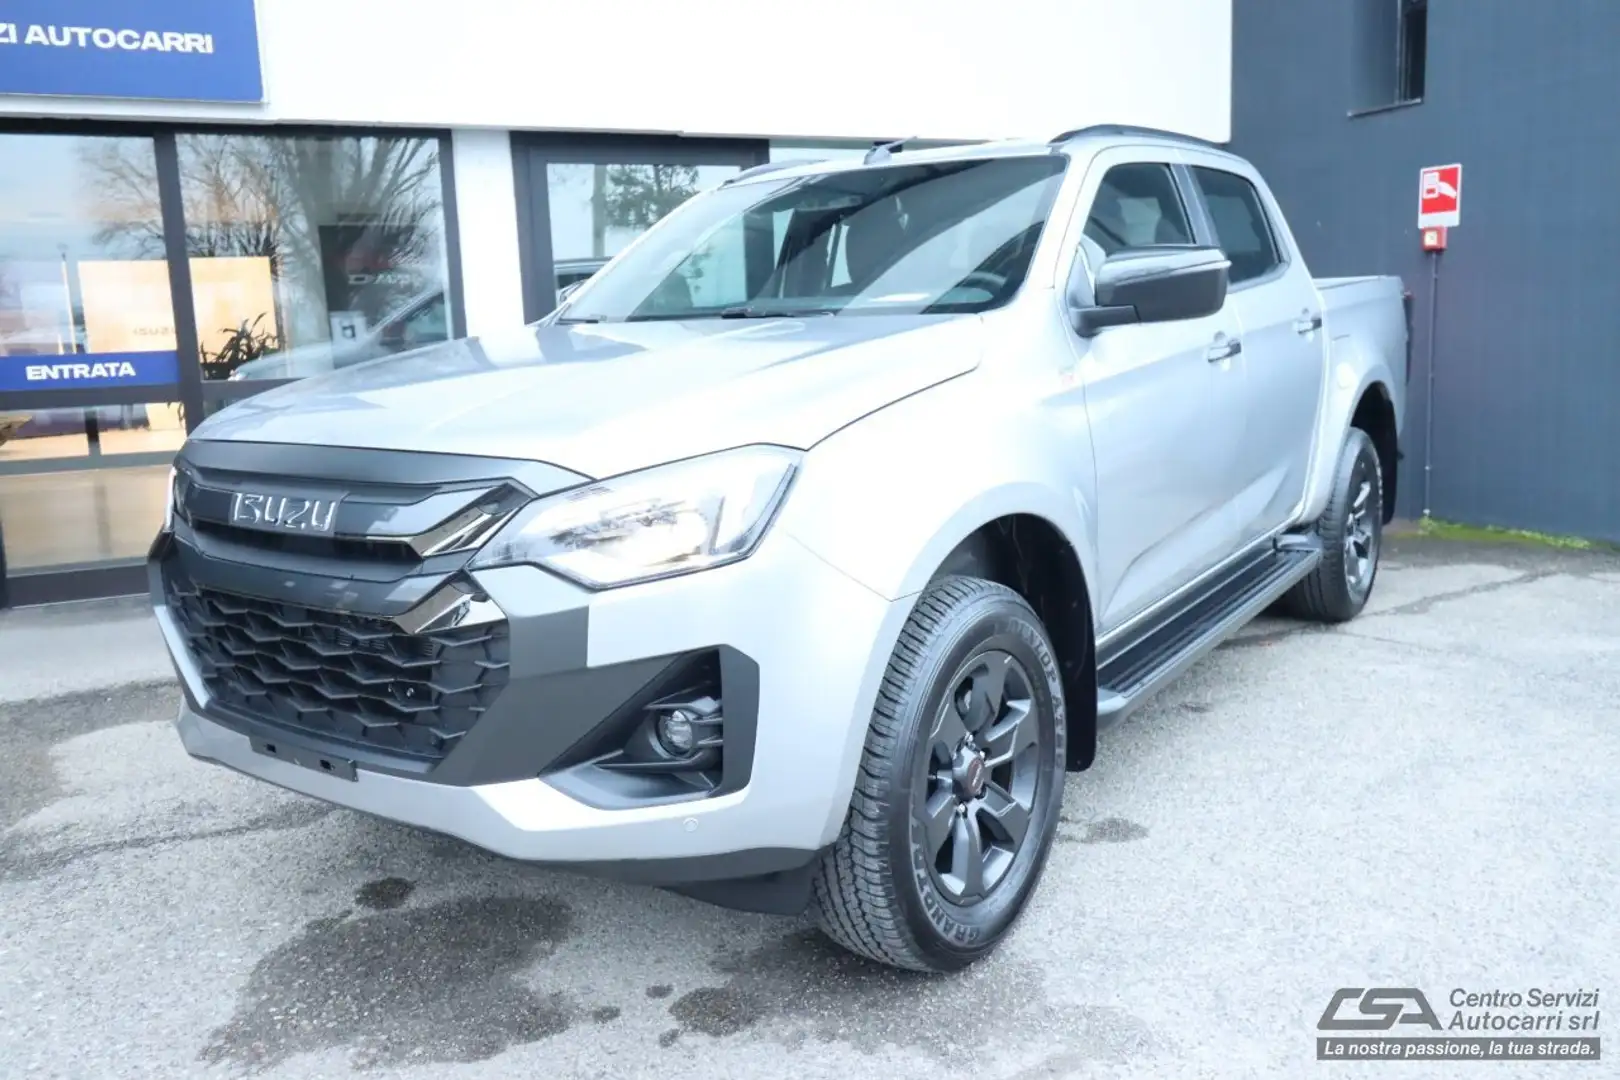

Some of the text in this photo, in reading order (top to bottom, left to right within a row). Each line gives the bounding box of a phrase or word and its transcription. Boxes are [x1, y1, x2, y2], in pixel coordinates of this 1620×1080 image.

[24, 24, 214, 54] AUTOCARRI
[133, 326, 174, 336] ISUZ
[25, 362, 136, 381] ENTRATA
[232, 492, 337, 532] ISUZU
